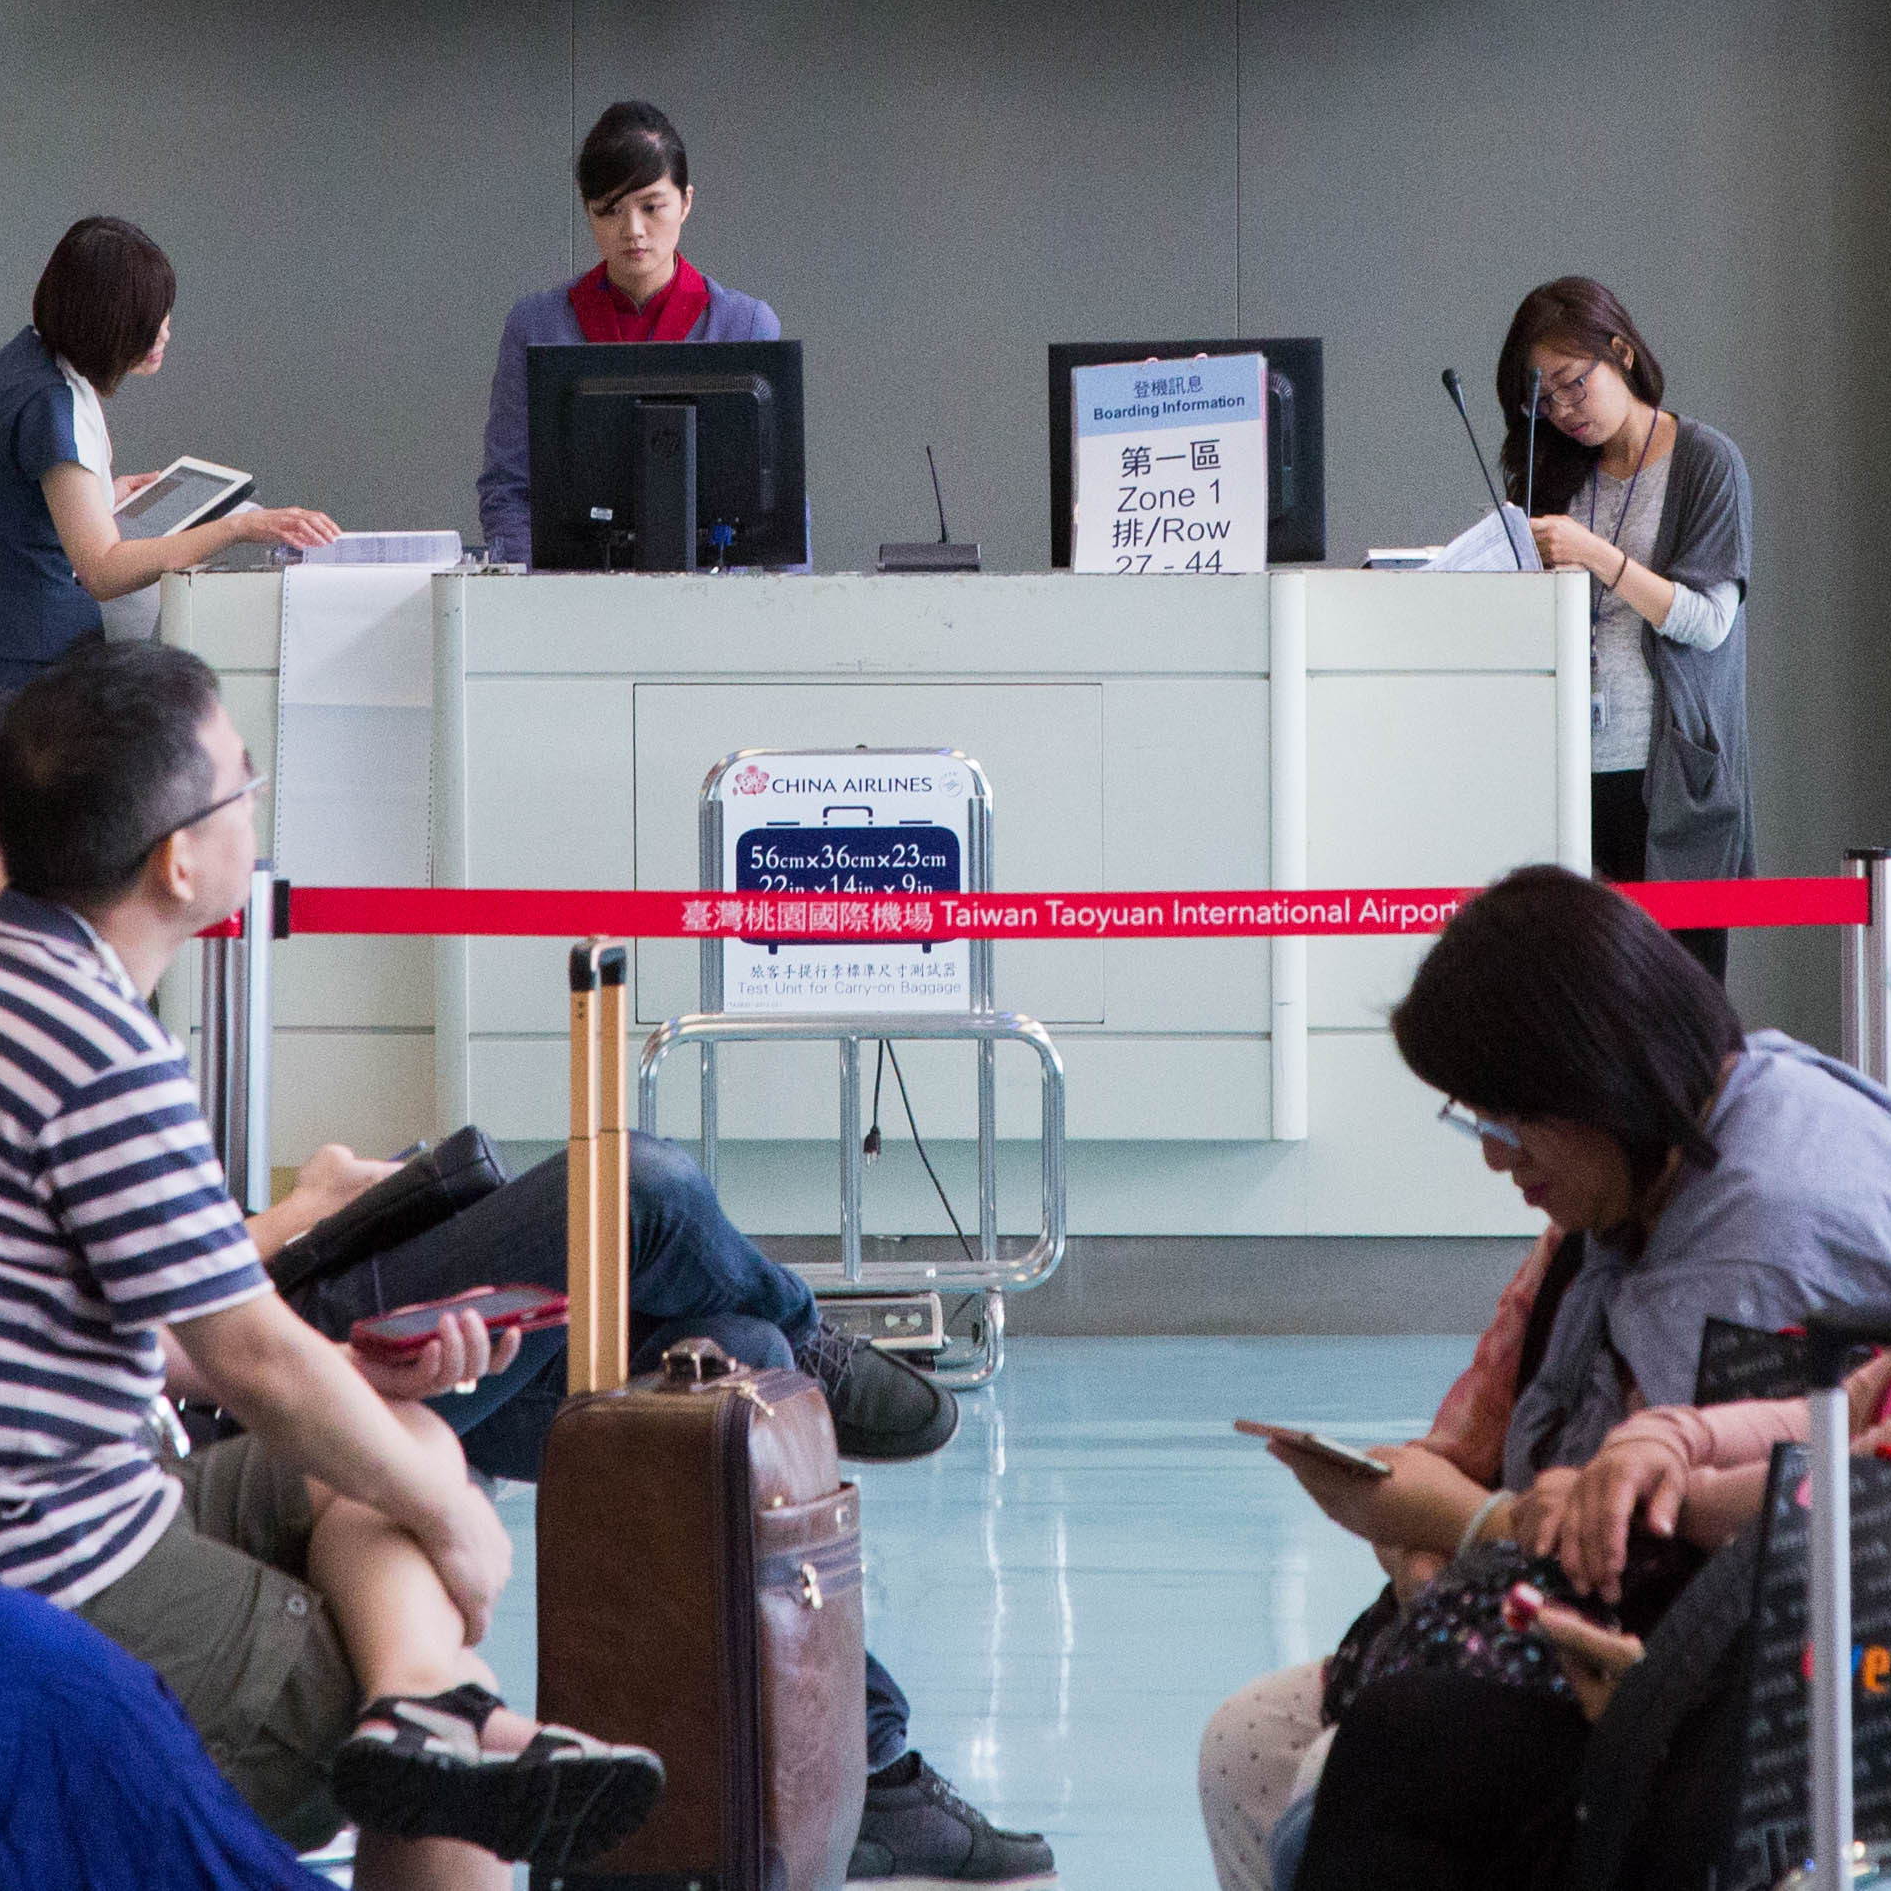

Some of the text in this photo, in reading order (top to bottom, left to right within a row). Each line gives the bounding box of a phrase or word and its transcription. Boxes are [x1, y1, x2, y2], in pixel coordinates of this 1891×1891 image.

[1134, 375, 1202, 399] 登機訊息
[1093, 395, 1245, 421] Boarding Information
[1121, 439, 1221, 478] 第一區
[1117, 479, 1221, 513] Zone 1
[1112, 516, 1231, 549] 排/Row
[1116, 554, 1152, 574] 27
[1185, 550, 1223, 573] 44
[772, 778, 837, 794] CHINA
[843, 777, 933, 793] AIRLINES
[682, 896, 1458, 933] 臺灣桃園國際機場 Taiwan Taoyuan International Airport
[738, 980, 961, 998] Test Unit for Carry-on Baggage
